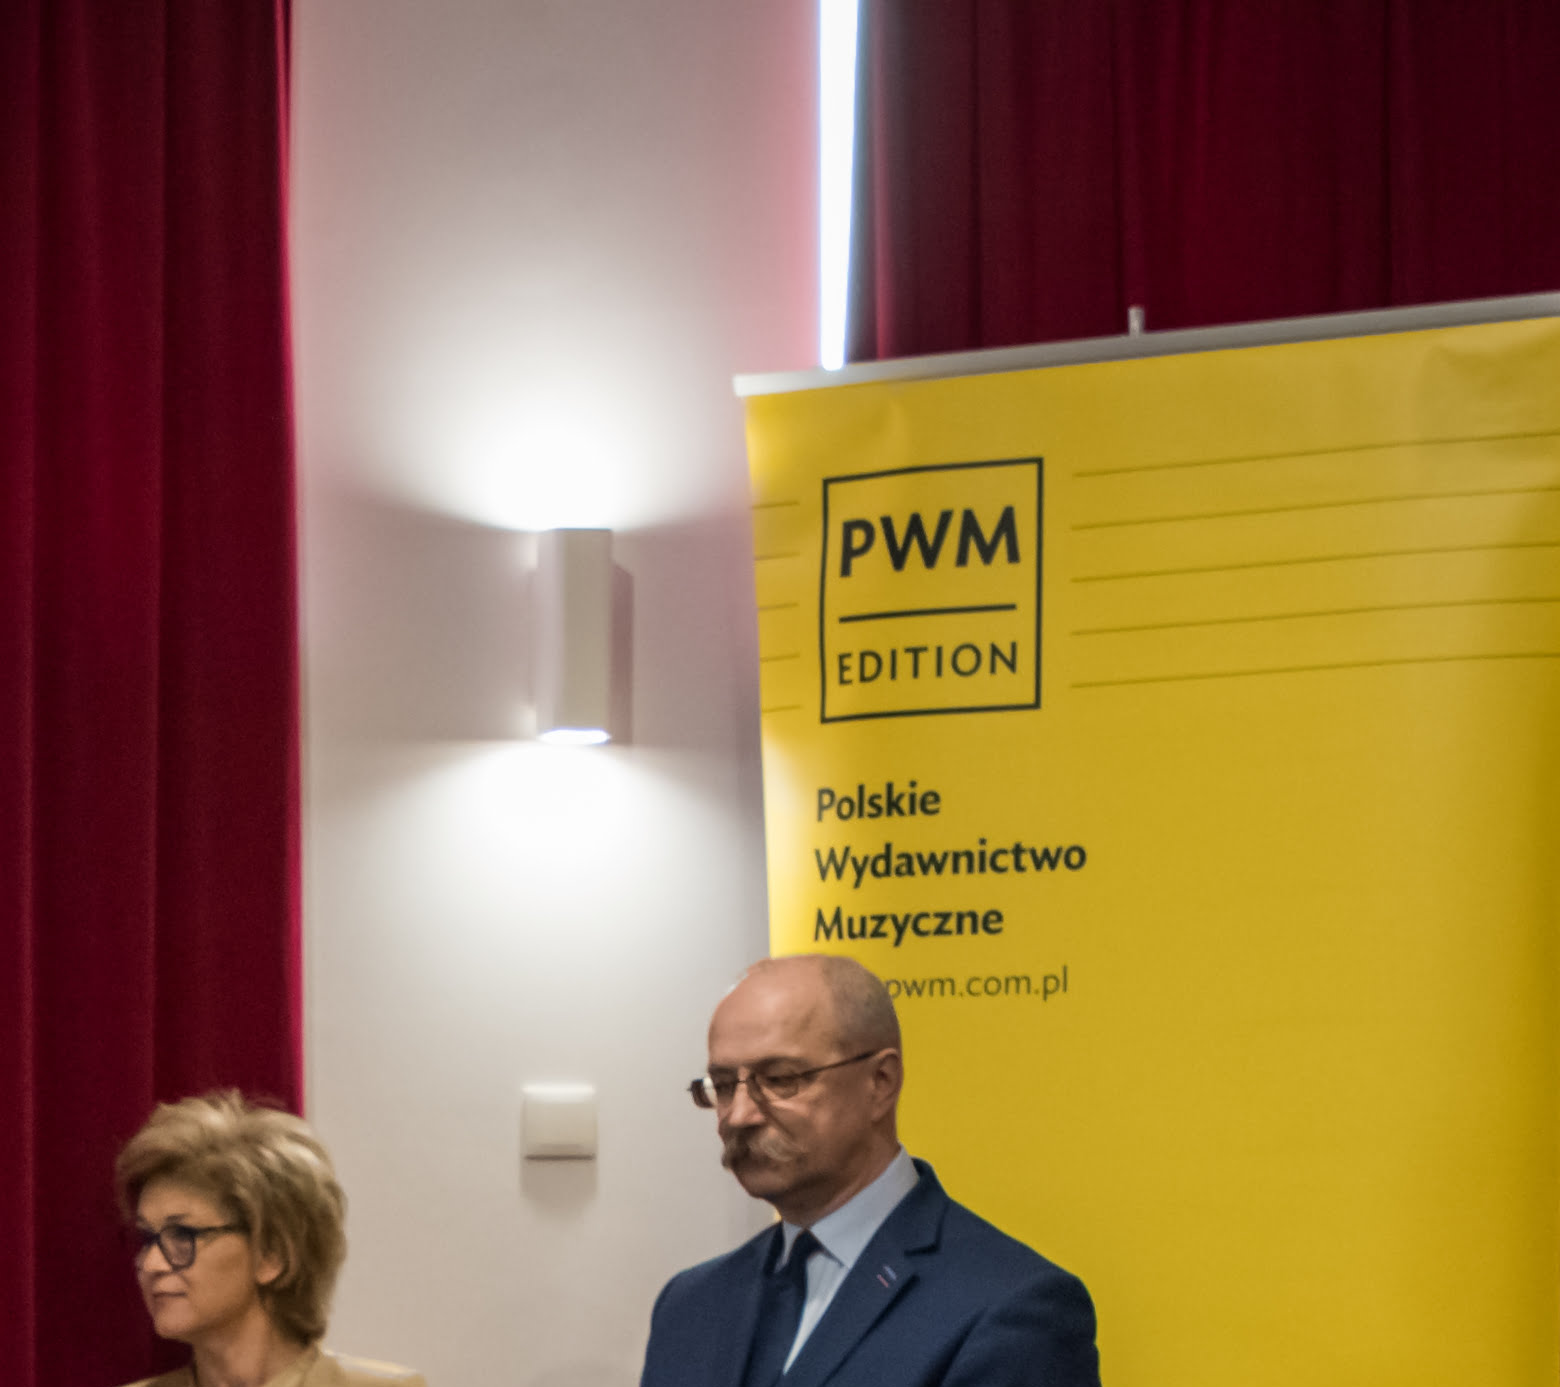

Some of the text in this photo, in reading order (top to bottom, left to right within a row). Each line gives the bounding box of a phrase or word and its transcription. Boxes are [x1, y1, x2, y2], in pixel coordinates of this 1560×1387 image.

[839, 505, 1021, 578] PWM
[838, 641, 1017, 686] EDITION
[817, 780, 941, 822] Polskie
[815, 838, 1087, 889] Wydawnictwo
[814, 906, 1004, 948] Muzyczne
